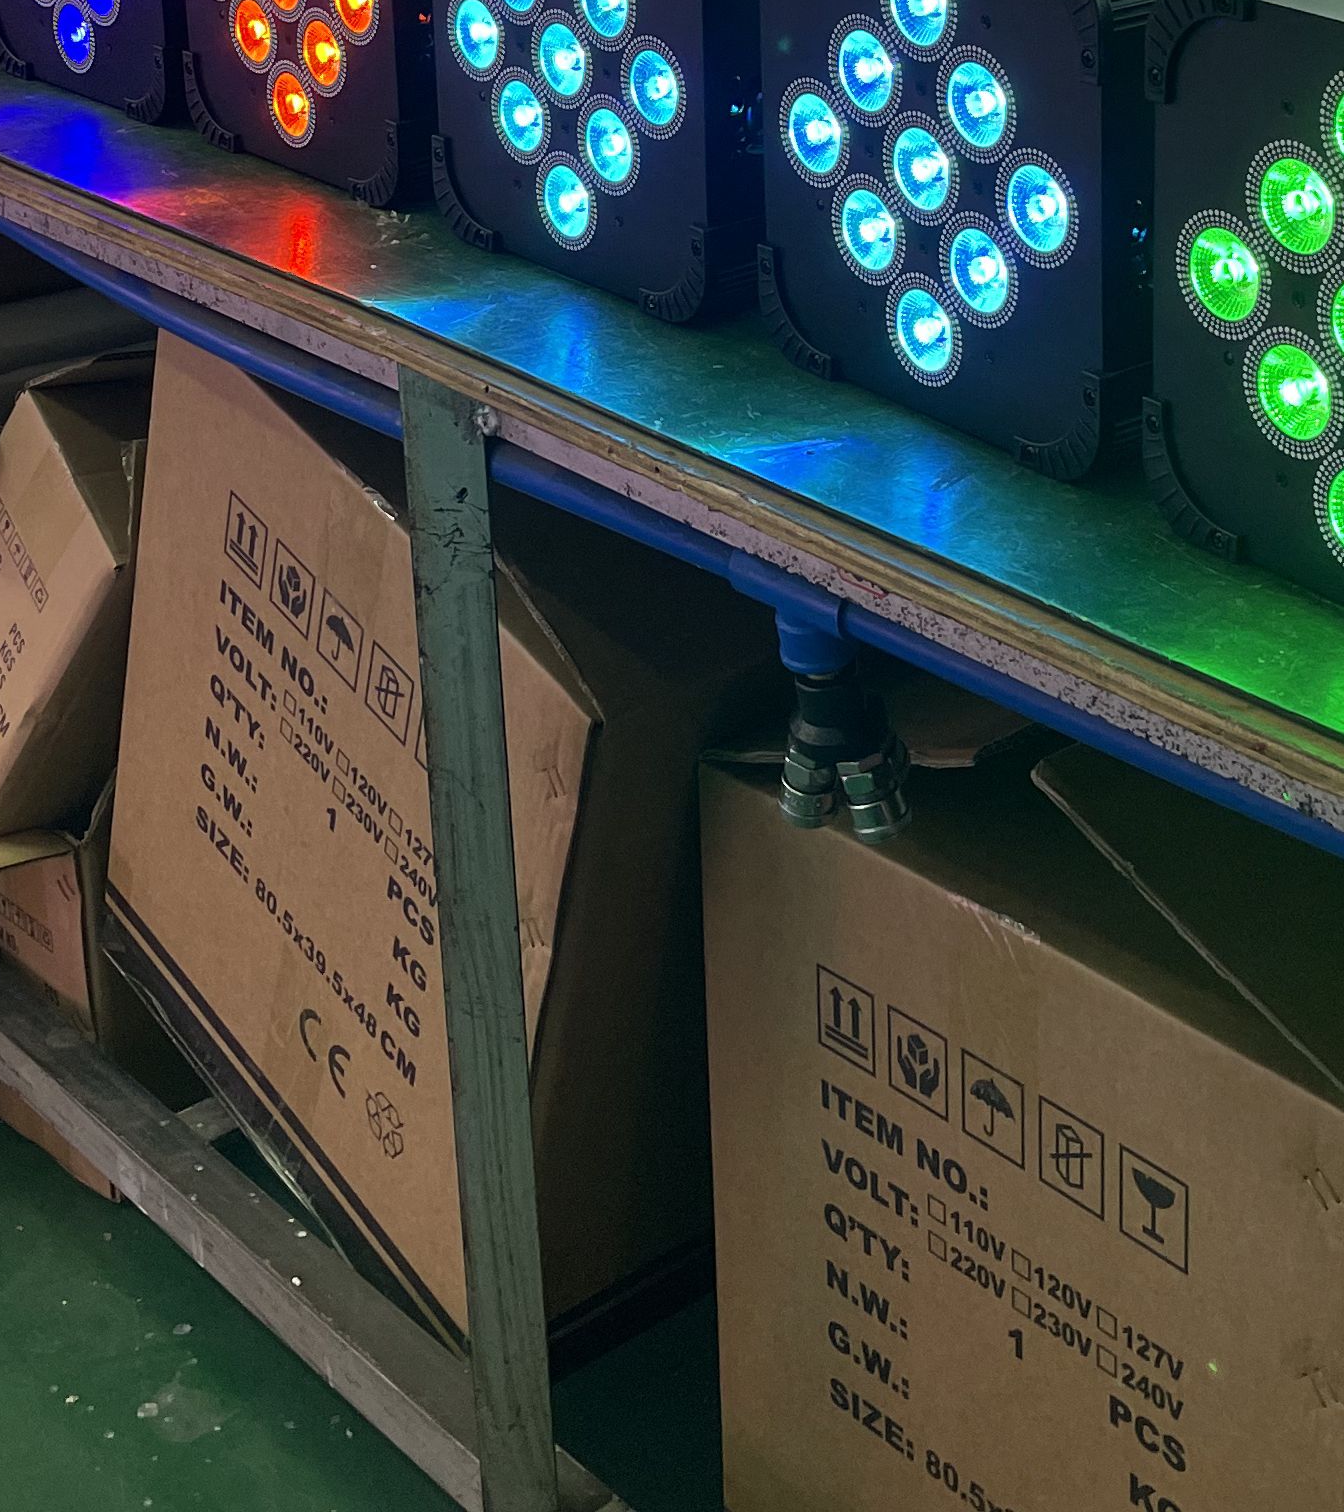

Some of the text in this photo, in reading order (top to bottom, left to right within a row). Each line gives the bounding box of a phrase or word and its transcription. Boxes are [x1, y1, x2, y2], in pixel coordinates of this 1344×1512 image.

[0, 640, 16, 672] KGS
[8, 622, 25, 654] PCS
[219, 579, 328, 714] ITEM NO.:
[216, 624, 433, 866] VOLT: 110V 120V 127
[205, 716, 427, 991] N.W.: KG
[294, 733, 438, 908] 220V 230V 240V
[326, 807, 336, 833] 1
[387, 874, 435, 946] PCS
[196, 805, 249, 884] SIZE:
[380, 1030, 417, 1088] CM
[201, 763, 421, 1038] G.W.: KG
[821, 1080, 989, 1211] ITEM NO.:
[821, 1138, 1185, 1382] VOLT: 110V 120V 127V
[825, 1259, 909, 1341] N.W.:
[827, 1320, 910, 1400] G.W.:
[950, 1246, 1184, 1421] 220V 230V 240V
[1007, 1328, 1024, 1361] 1
[1109, 1393, 1187, 1473] PCS
[830, 1377, 915, 1461] SIZE:
